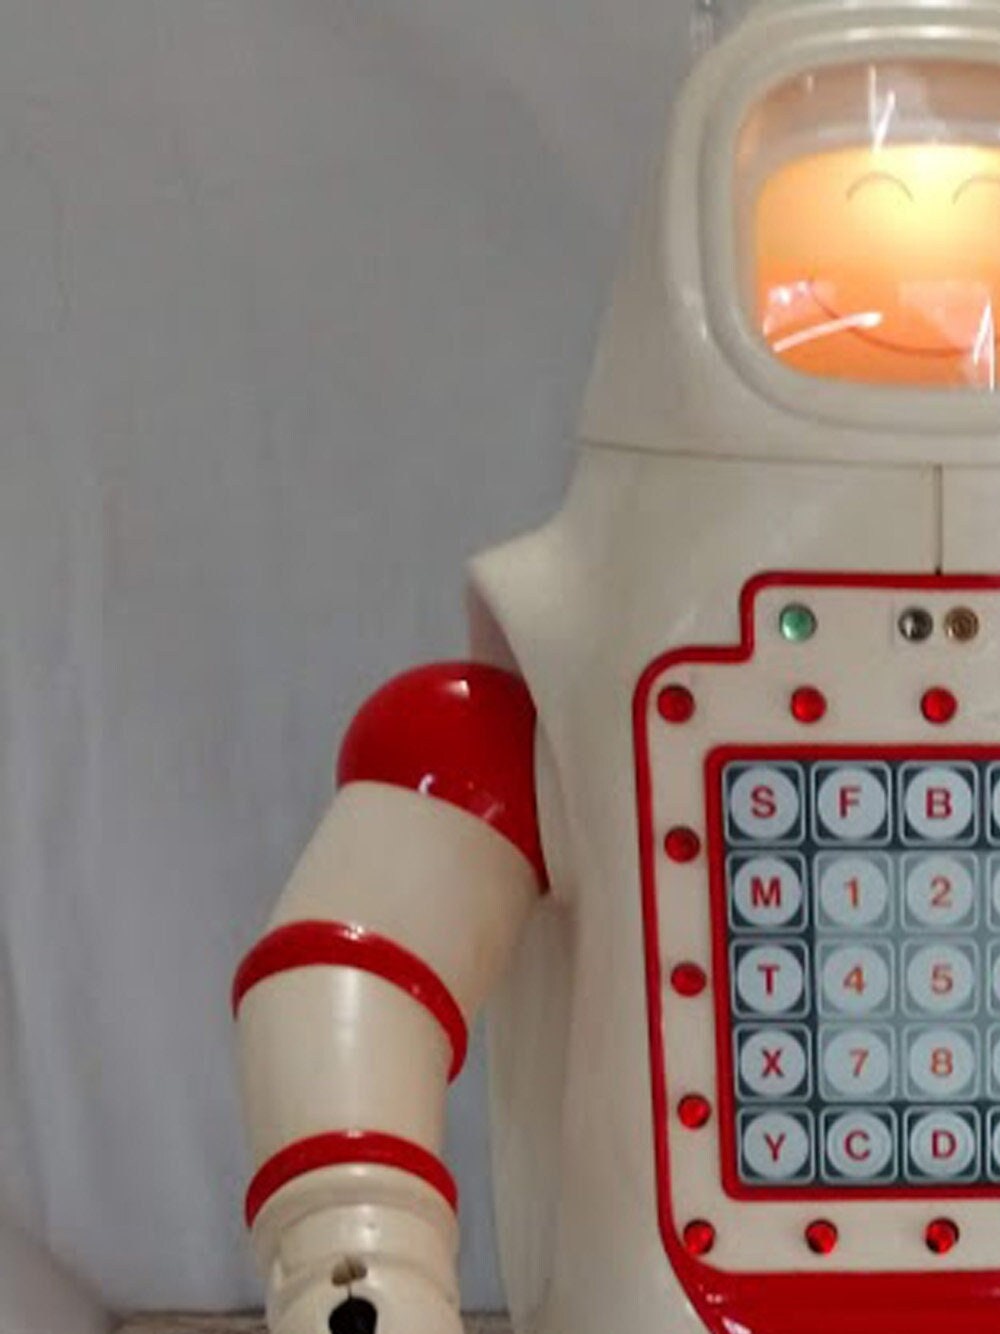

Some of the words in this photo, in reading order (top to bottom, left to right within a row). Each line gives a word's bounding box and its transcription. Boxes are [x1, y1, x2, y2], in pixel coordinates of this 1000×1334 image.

[749, 784, 777, 819] S
[839, 786, 861, 818] F
[926, 787, 952, 818] B
[751, 877, 781, 908] M
[845, 877, 859, 908] 1
[930, 877, 951, 908] 2
[757, 964, 780, 994] T
[843, 965, 865, 993] 4
[931, 964, 953, 994] 5
[761, 1049, 783, 1078] X
[850, 1049, 869, 1077] 7
[930, 1048, 953, 1077] 8
[764, 1132, 786, 1162] Y
[844, 1130, 871, 1160] C
[931, 1130, 957, 1159] D
